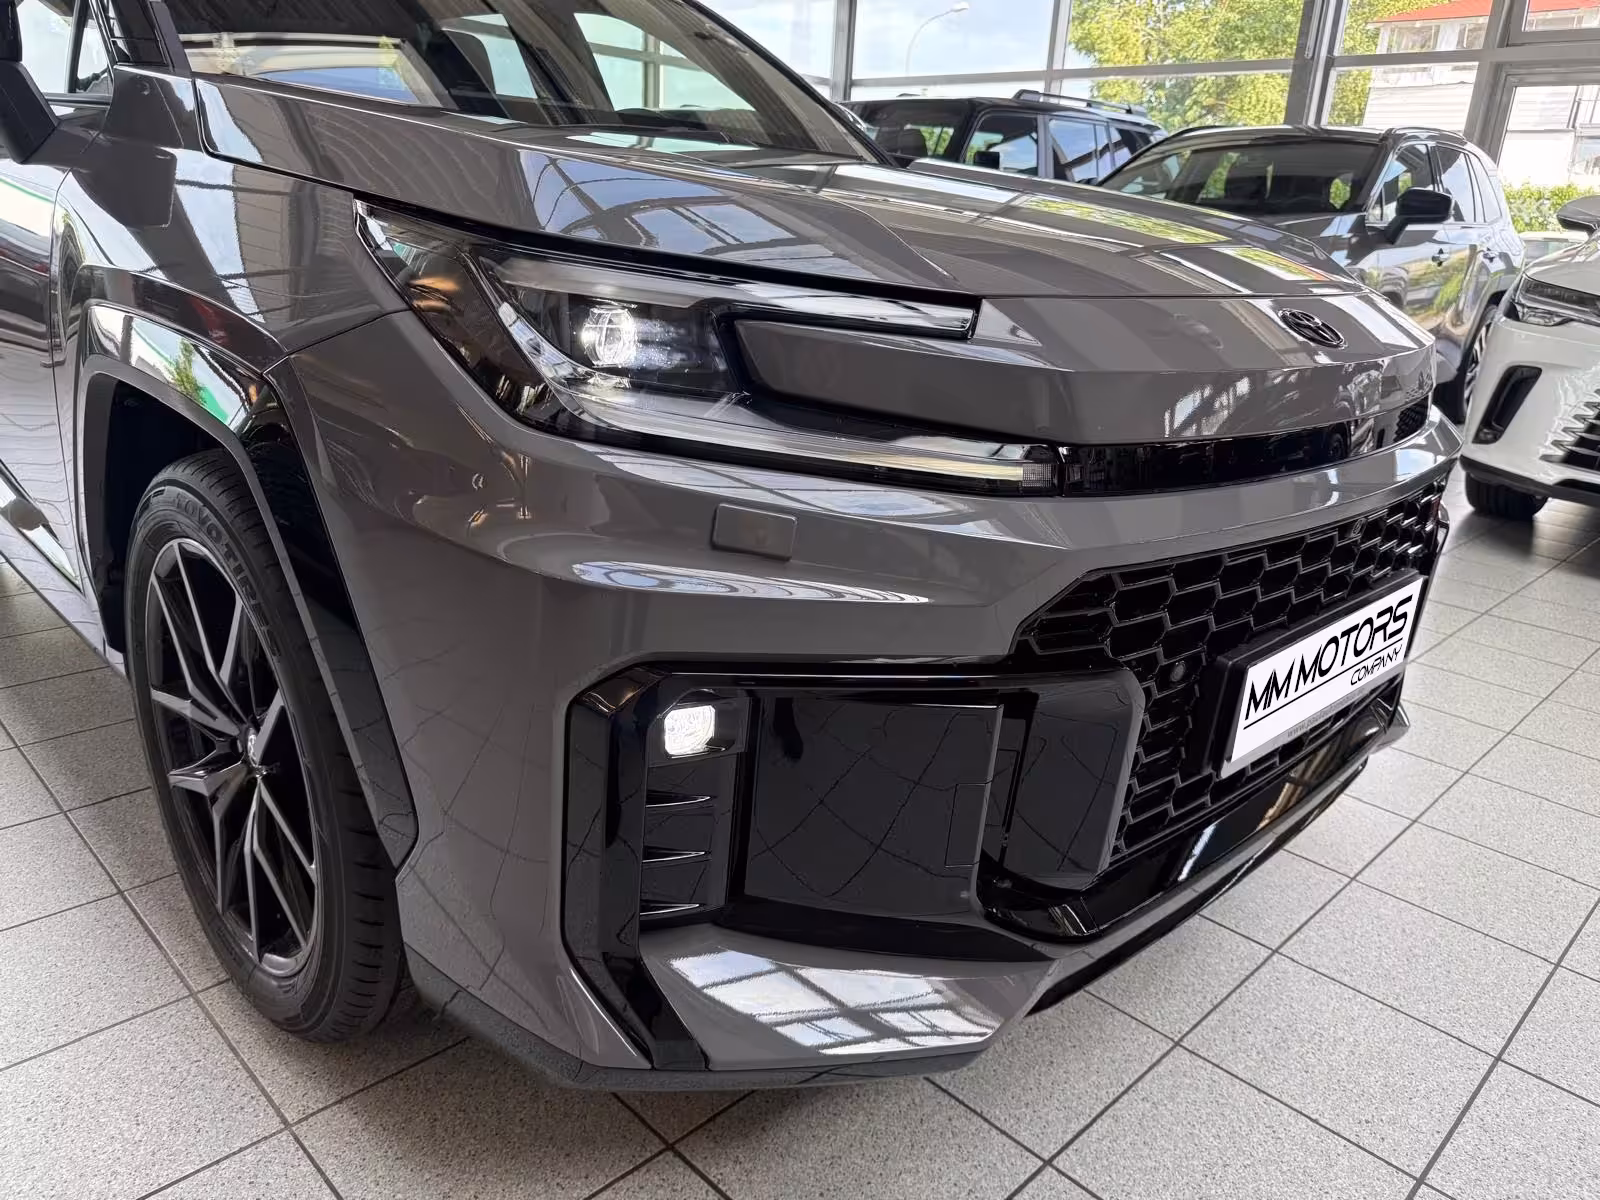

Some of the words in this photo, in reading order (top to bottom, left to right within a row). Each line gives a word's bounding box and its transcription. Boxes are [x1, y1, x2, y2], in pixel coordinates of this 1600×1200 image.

[176, 493, 223, 544] TOYO
[1245, 658, 1296, 720] MM
[1294, 594, 1413, 692] MOTORS
[1350, 644, 1403, 686] COMPANY
